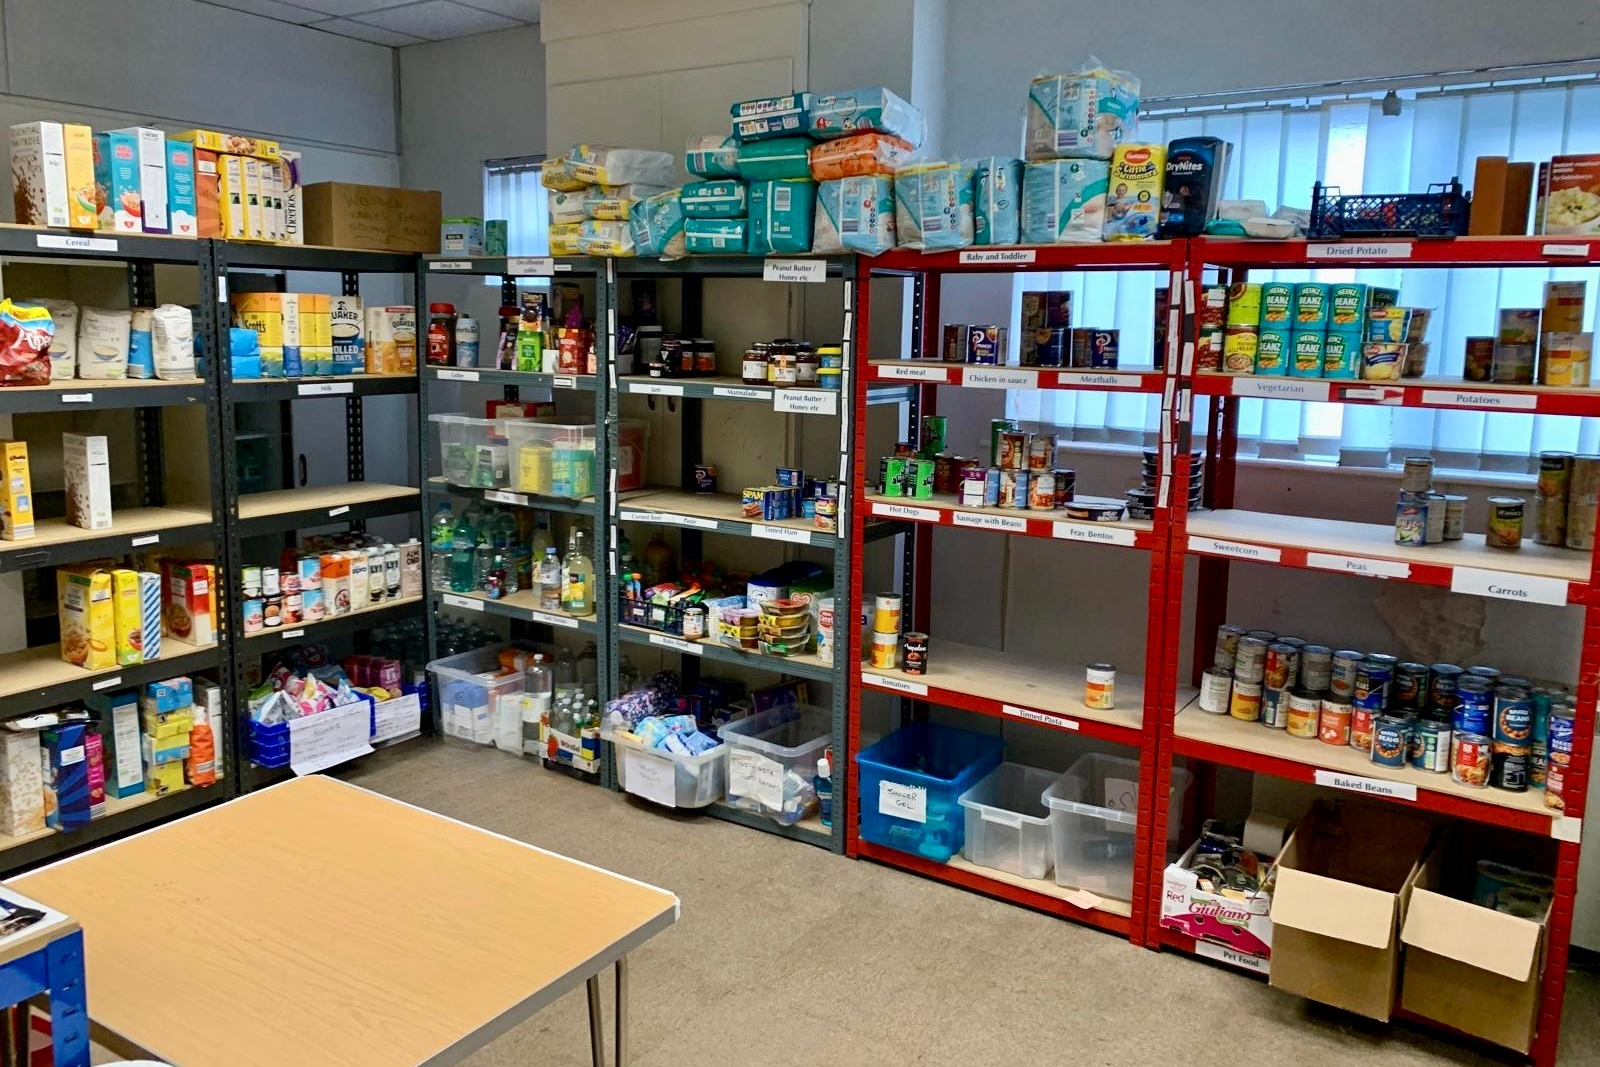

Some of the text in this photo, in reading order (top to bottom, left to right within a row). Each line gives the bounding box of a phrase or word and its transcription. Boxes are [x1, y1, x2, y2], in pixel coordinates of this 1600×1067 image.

[1166, 161, 1203, 172] DryNites
[65, 237, 91, 248] Cereal
[1326, 245, 1388, 256] Dried Potato
[966, 252, 984, 262] Baby
[1001, 252, 1027, 261] Toddler
[772, 263, 793, 272] Peanut
[794, 264, 812, 272] Butter
[1269, 286, 1289, 295] HEINZ
[1301, 287, 1321, 295] HEINZ
[1338, 288, 1357, 296] HEINZ
[1266, 296, 1290, 305] BEANZ
[1298, 296, 1322, 305] BEANZ
[1335, 297, 1358, 306] BEANZ
[1299, 334, 1319, 342] HEINZ
[1296, 343, 1320, 353] BEANZ
[896, 368, 926, 377] Red meat
[969, 373, 1028, 385] Chicken in sauce
[1080, 375, 1119, 385] Meatballs
[727, 388, 758, 397] Marmalade
[1257, 382, 1305, 394] Vegetarian
[783, 393, 803, 402] Peanut
[804, 395, 822, 403] Butter
[1456, 393, 1501, 405] Potatoes
[742, 489, 764, 500] SPAM
[889, 505, 920, 517] Hot Dogs
[956, 513, 1022, 528] Sausage with Beans
[784, 528, 798, 536] Ham
[1070, 528, 1114, 540] Fray Bentos
[1213, 541, 1259, 557] Sweetcorn
[1346, 559, 1367, 572] Peas
[1488, 584, 1528, 599] Carrots
[882, 678, 911, 690] Tomatoes
[1019, 709, 1063, 726] Tinned Pasta
[1334, 777, 1393, 795] Baked Beans
[1188, 901, 1252, 922] Giuliano
[1223, 950, 1259, 967] Pet Food
